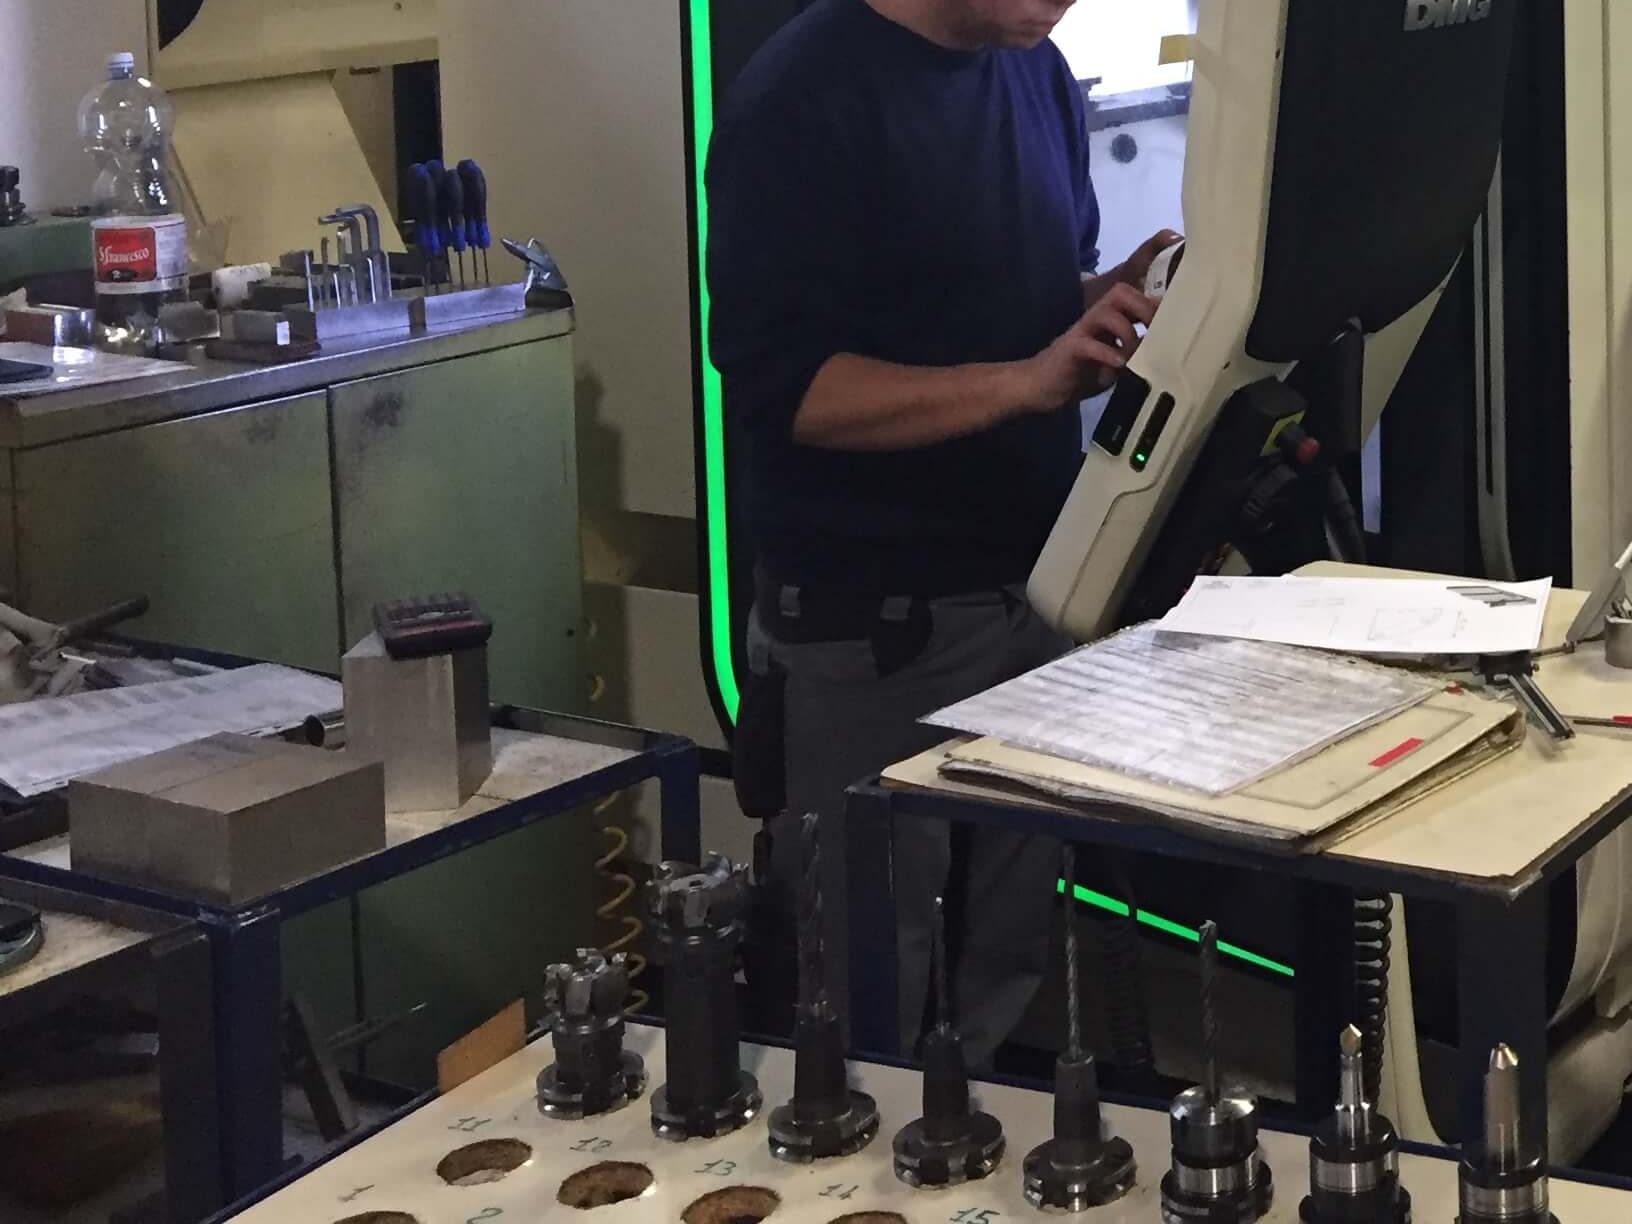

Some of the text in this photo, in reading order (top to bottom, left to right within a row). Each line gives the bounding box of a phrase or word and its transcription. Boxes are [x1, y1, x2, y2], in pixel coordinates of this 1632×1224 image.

[569, 1136, 613, 1153] 12
[694, 1158, 737, 1177] 13
[818, 1182, 860, 1200] 14
